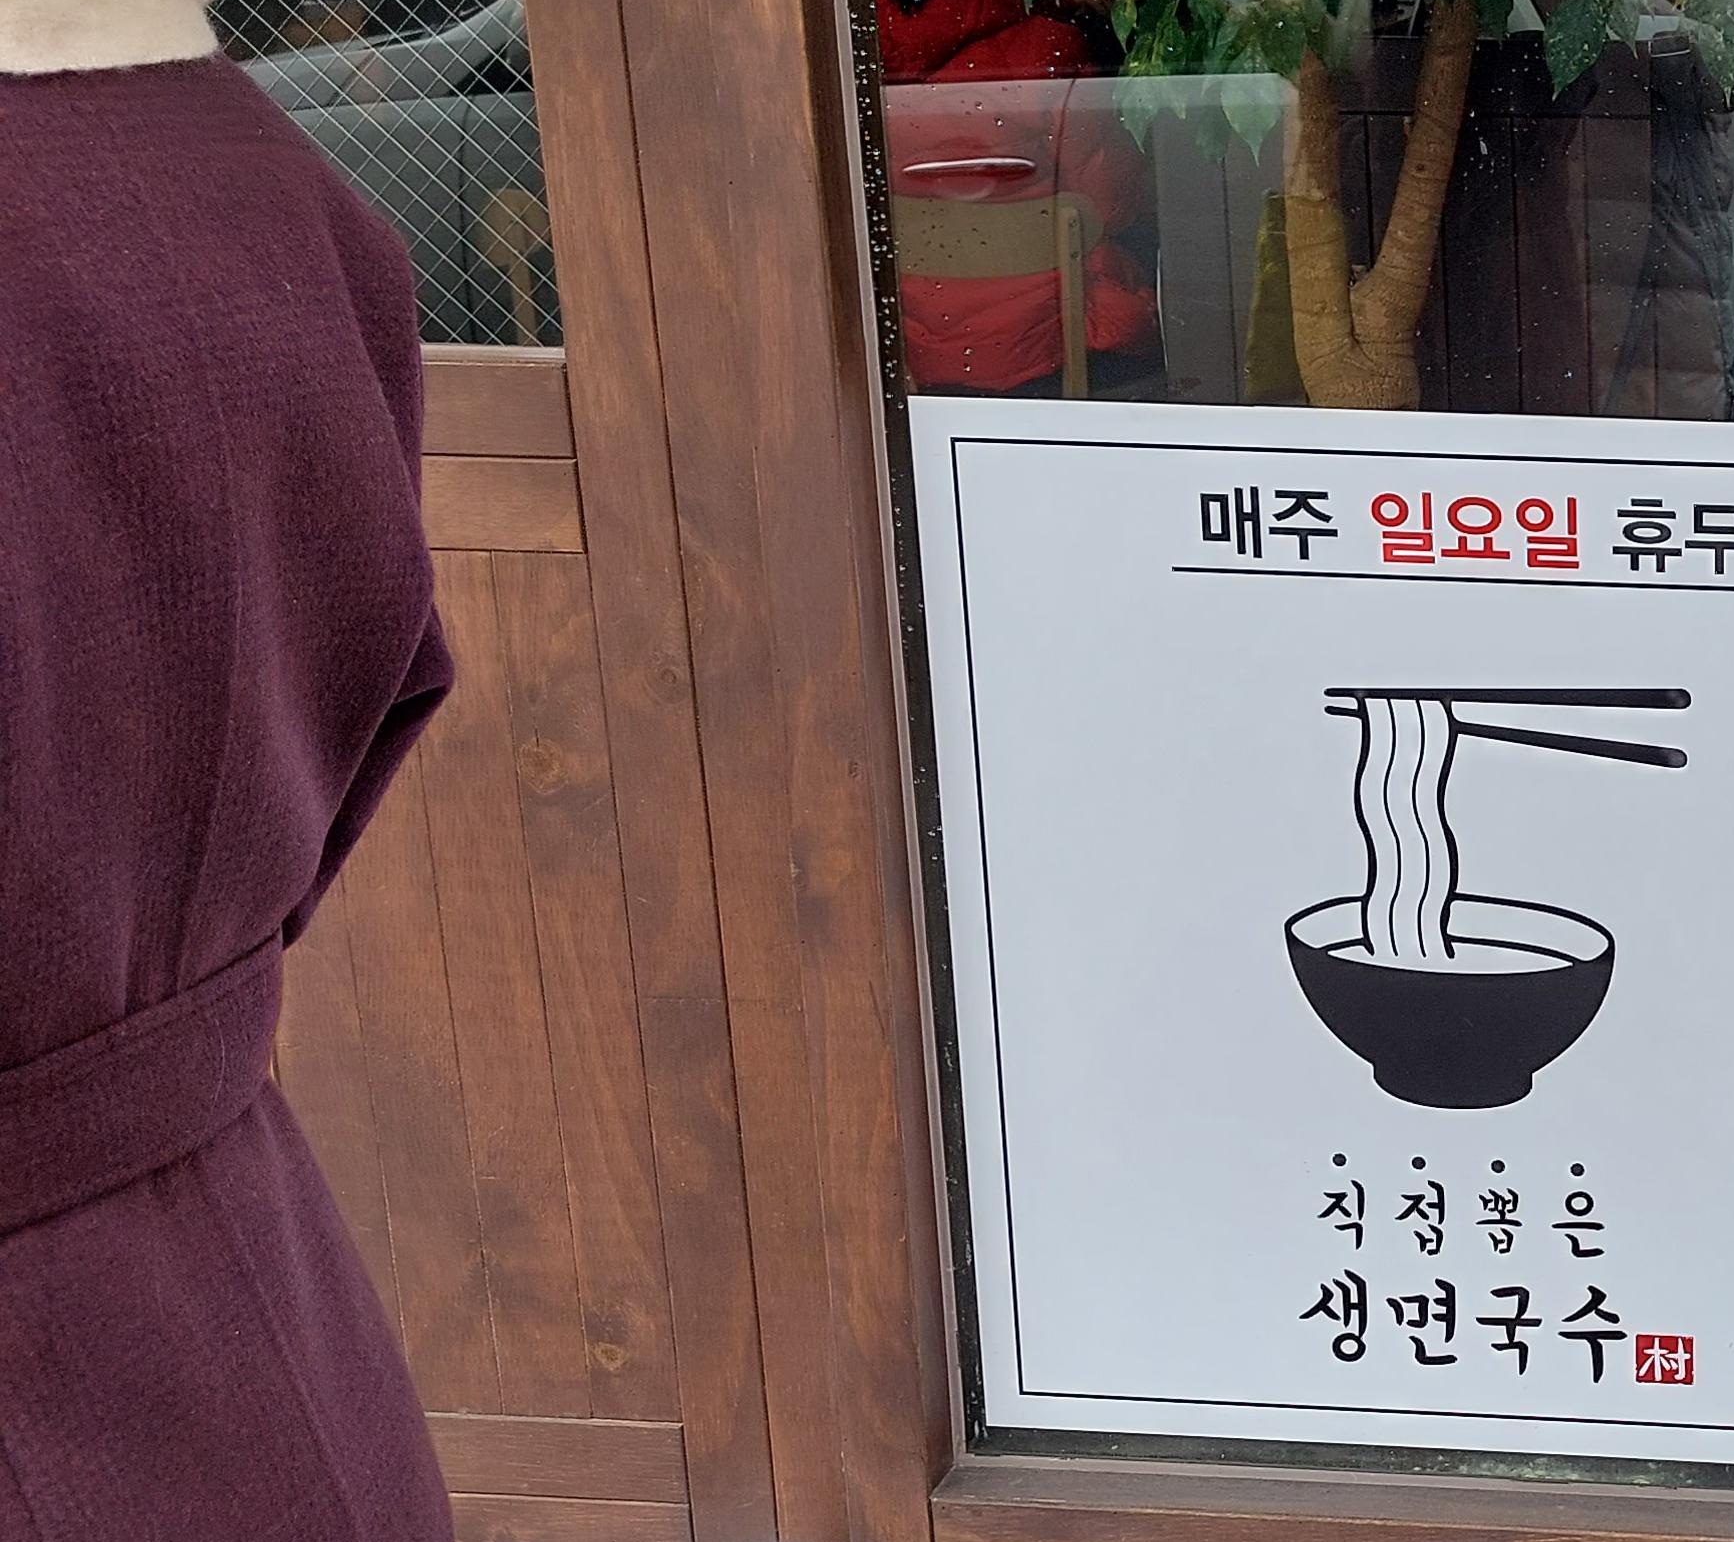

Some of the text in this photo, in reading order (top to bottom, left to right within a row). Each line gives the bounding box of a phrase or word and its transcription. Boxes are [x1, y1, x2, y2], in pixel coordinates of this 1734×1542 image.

[1200, 486, 1338, 560] 매주
[1371, 492, 1580, 569] 일요일
[1299, 1269, 1691, 1383] 생면국수 村
